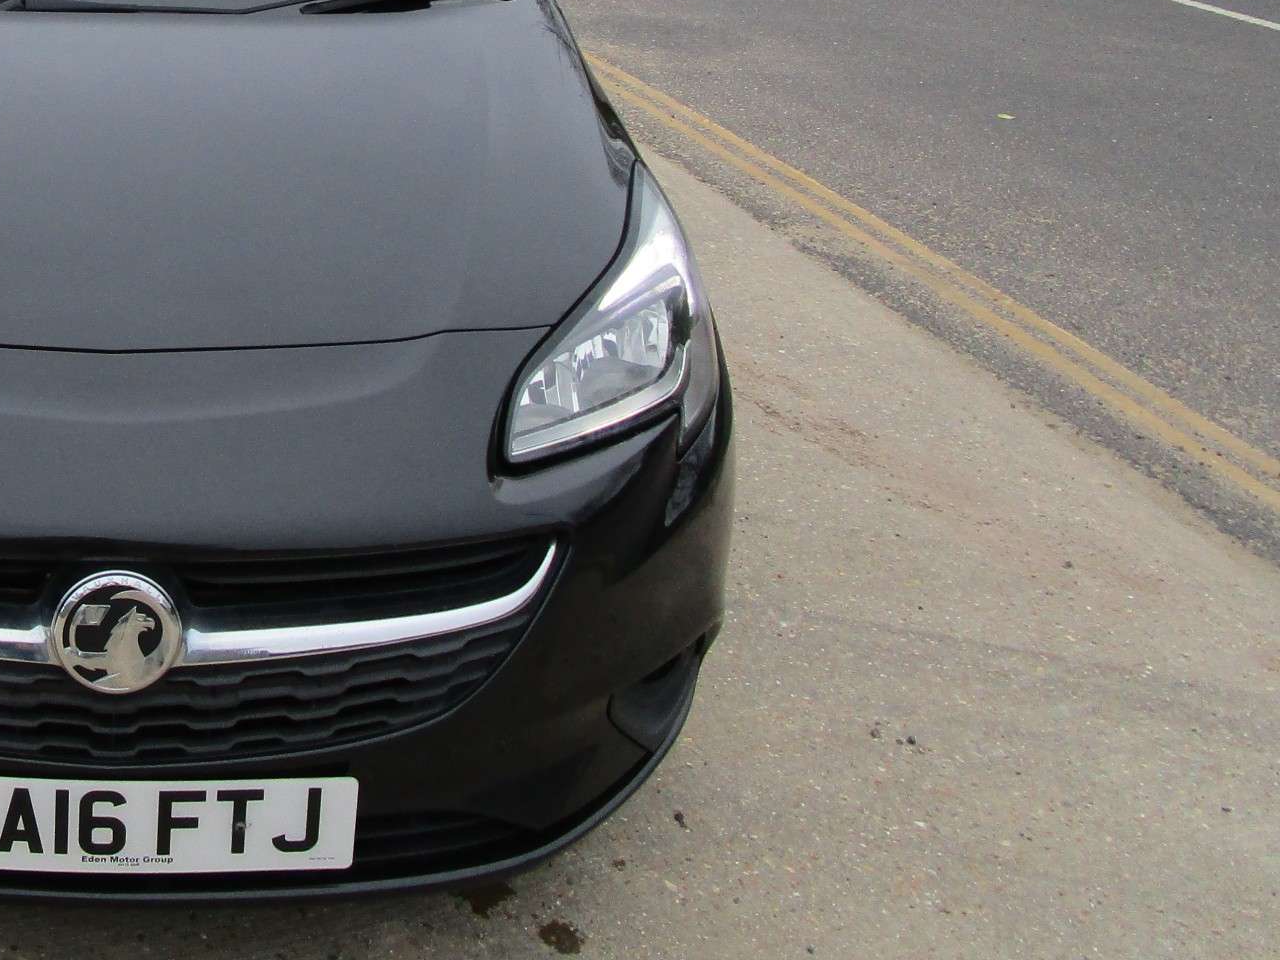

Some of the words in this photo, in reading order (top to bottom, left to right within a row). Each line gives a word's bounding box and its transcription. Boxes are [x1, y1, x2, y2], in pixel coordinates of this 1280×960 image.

[156, 787, 322, 855] FTJ
[81, 855, 107, 863] Eden
[110, 855, 140, 863] Motor
[142, 855, 174, 865] Group
